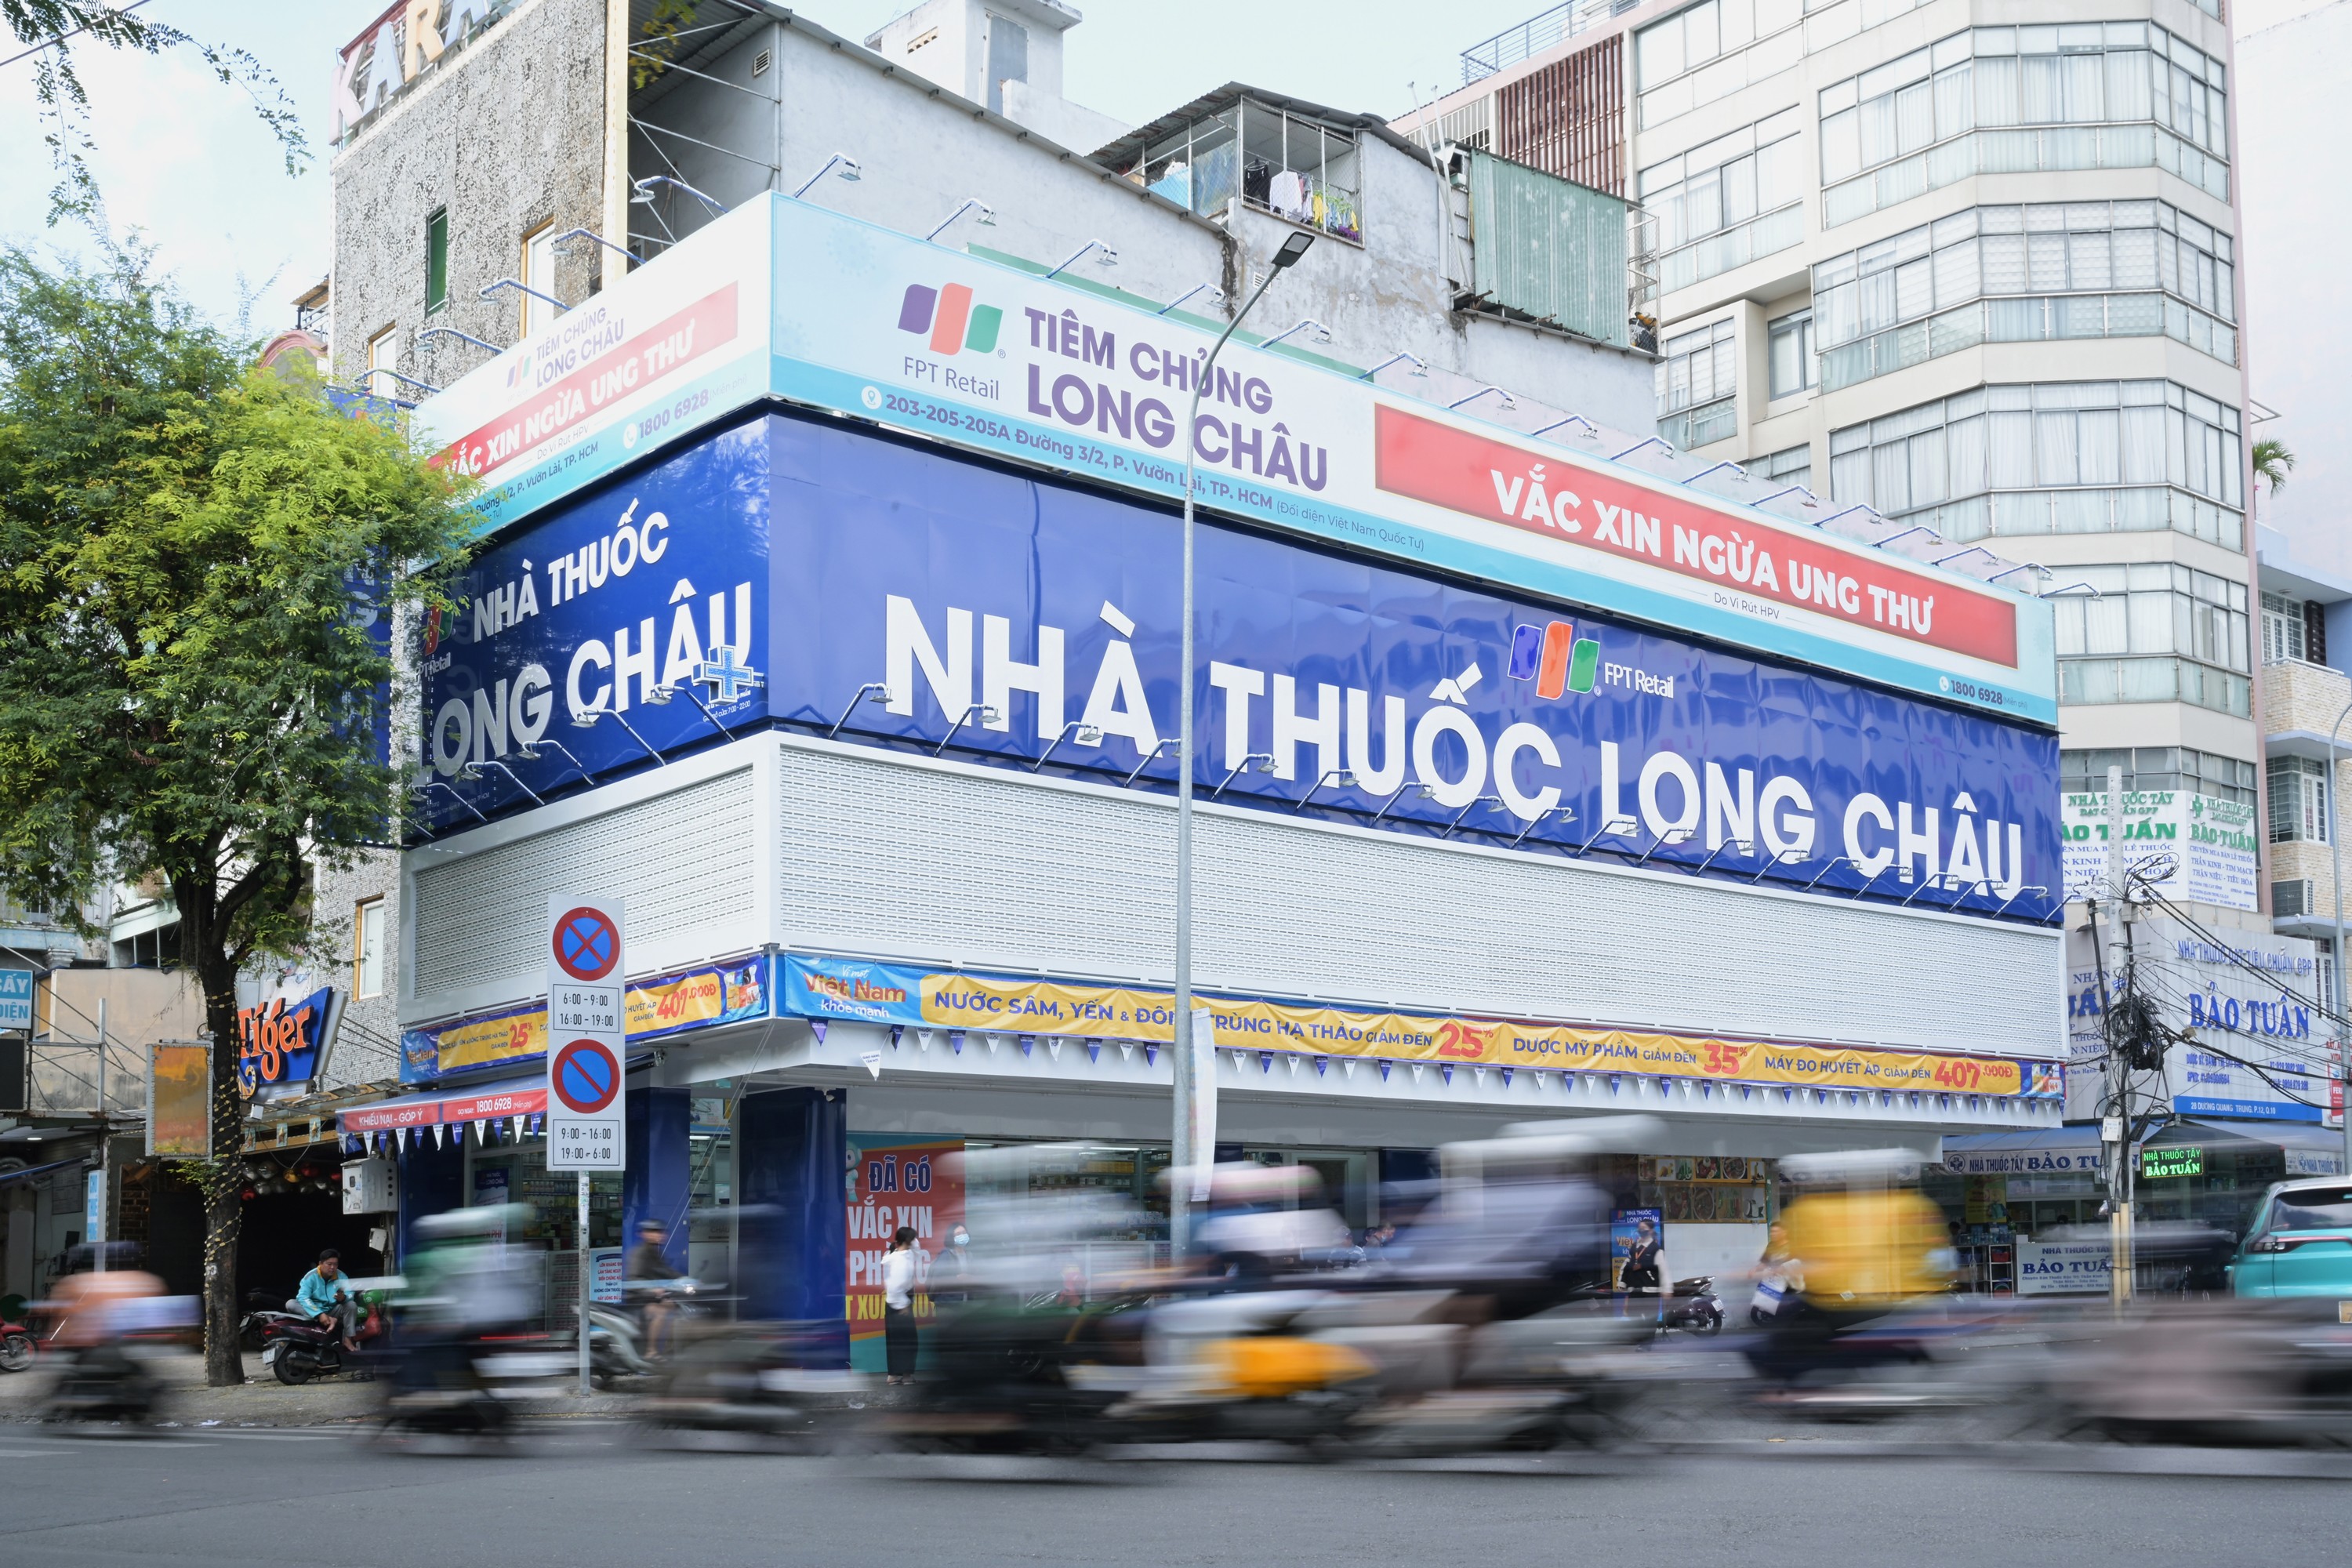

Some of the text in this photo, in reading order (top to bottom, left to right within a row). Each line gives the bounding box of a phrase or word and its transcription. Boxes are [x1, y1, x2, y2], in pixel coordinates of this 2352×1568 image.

[536, 307, 606, 361] TIÊM CHỦNG
[537, 318, 624, 388] LONG CHÂU
[1025, 307, 1272, 416] TIÊM CHỦNG
[486, 423, 520, 466] XIN
[524, 388, 586, 443] NGỪA
[591, 357, 638, 406] UNG
[644, 318, 695, 376] THƯ
[904, 356, 1000, 401] FPT Retail
[639, 408, 670, 439] 1800
[674, 389, 709, 420] 6928
[1028, 362, 1327, 492] LONG CHÂU
[537, 448, 547, 459] Do
[572, 423, 590, 442] HPV
[526, 470, 547, 488] Vườn
[564, 453, 577, 469] TP.
[579, 441, 599, 461] HCM
[886, 393, 1011, 441] 203-205-205A
[1014, 427, 1073, 460] Đường
[1078, 445, 1109, 470] 3/2,
[1113, 454, 1128, 472] P.
[1132, 459, 1174, 485] Vườn
[1210, 480, 1234, 499] TP.
[1237, 488, 1272, 510] HCM
[1276, 500, 1298, 517] (Đối
[1301, 509, 1325, 525] diện
[1328, 514, 1348, 532] Việt
[1352, 521, 1376, 538] Nam
[1379, 528, 1406, 546] Quốc
[1409, 535, 1425, 553] Tự)
[1490, 463, 1934, 636] VẮC XIN NGỪA UNG THƯ
[474, 498, 670, 643] NHÀ THUỐC
[1714, 592, 1780, 620] Do Vi Rút HPV
[430, 651, 452, 677] Retail
[566, 578, 751, 724] CHÂU
[1604, 661, 1675, 700] FPT Retail
[1951, 679, 2003, 705] 1800 6928
[728, 700, 751, 714] 7:00 22:00
[886, 593, 2024, 902] NHÀ THUỐC LONG CHÂU
[2068, 790, 2175, 807] NHÀ TUỐC TÂY
[2138, 807, 2158, 815] GPP
[2140, 842, 2174, 851] THUỐC
[2190, 821, 2256, 852] BẢO TUẤN
[2207, 860, 2221, 869] KINH
[2226, 863, 2235, 873] TIM
[2209, 849, 2220, 858] MUA
[2296, 957, 2312, 976] GPP
[563, 992, 608, 1007] 6:00 9:00
[803, 972, 906, 1003] Việt Nam
[627, 1001, 657, 1014] HUYẾT ÁP
[821, 999, 890, 1020] khỏe mạnh
[2188, 981, 2240, 1029] BẢO
[560, 1012, 614, 1027] 16:00 19:00
[935, 989, 1494, 1058] NƯỚC SÂM, YẾN & TRÙNG HẠ THẢO GIẢM ĐẾN 25%
[238, 997, 311, 1081] Tiger
[1513, 1037, 1748, 1075] DƯỢC MỸ PHẨM GIẢM ĐẾN 35%
[1764, 1055, 1794, 1071] MÁY
[1796, 1058, 1817, 1073] ĐO
[1819, 1058, 1862, 1076] HUYẾT
[1864, 1058, 1881, 1076] ÁP
[1883, 1065, 1910, 1079] GIẢM
[1911, 1065, 1932, 1080] ĐẾN
[359, 1111, 379, 1127] KHIẾU
[380, 1113, 393, 1128] NẠI
[399, 1110, 416, 1123] GÓP
[417, 1108, 423, 1121] Ý
[477, 1097, 512, 1112] 1800 6928
[2216, 1102, 2233, 1112] QUANG
[561, 1127, 579, 1140] 9:00
[590, 1127, 612, 1140] 16:00
[561, 1147, 611, 1160] 19:00 6:00
[1969, 1152, 2072, 1172] NHÀ THUỐC TÂY BẢO
[2143, 1147, 2201, 1161] NHÀ THUỐC TÂY
[2146, 1159, 2200, 1176] BẢO TUẤN
[868, 1154, 932, 1193] ĐÃ CÓ
[848, 1194, 933, 1240] VẮC XIN
[849, 1241, 931, 1287] PHG
[2064, 1246, 2094, 1254] THUỐC
[2023, 1258, 2064, 1275] BẢO
